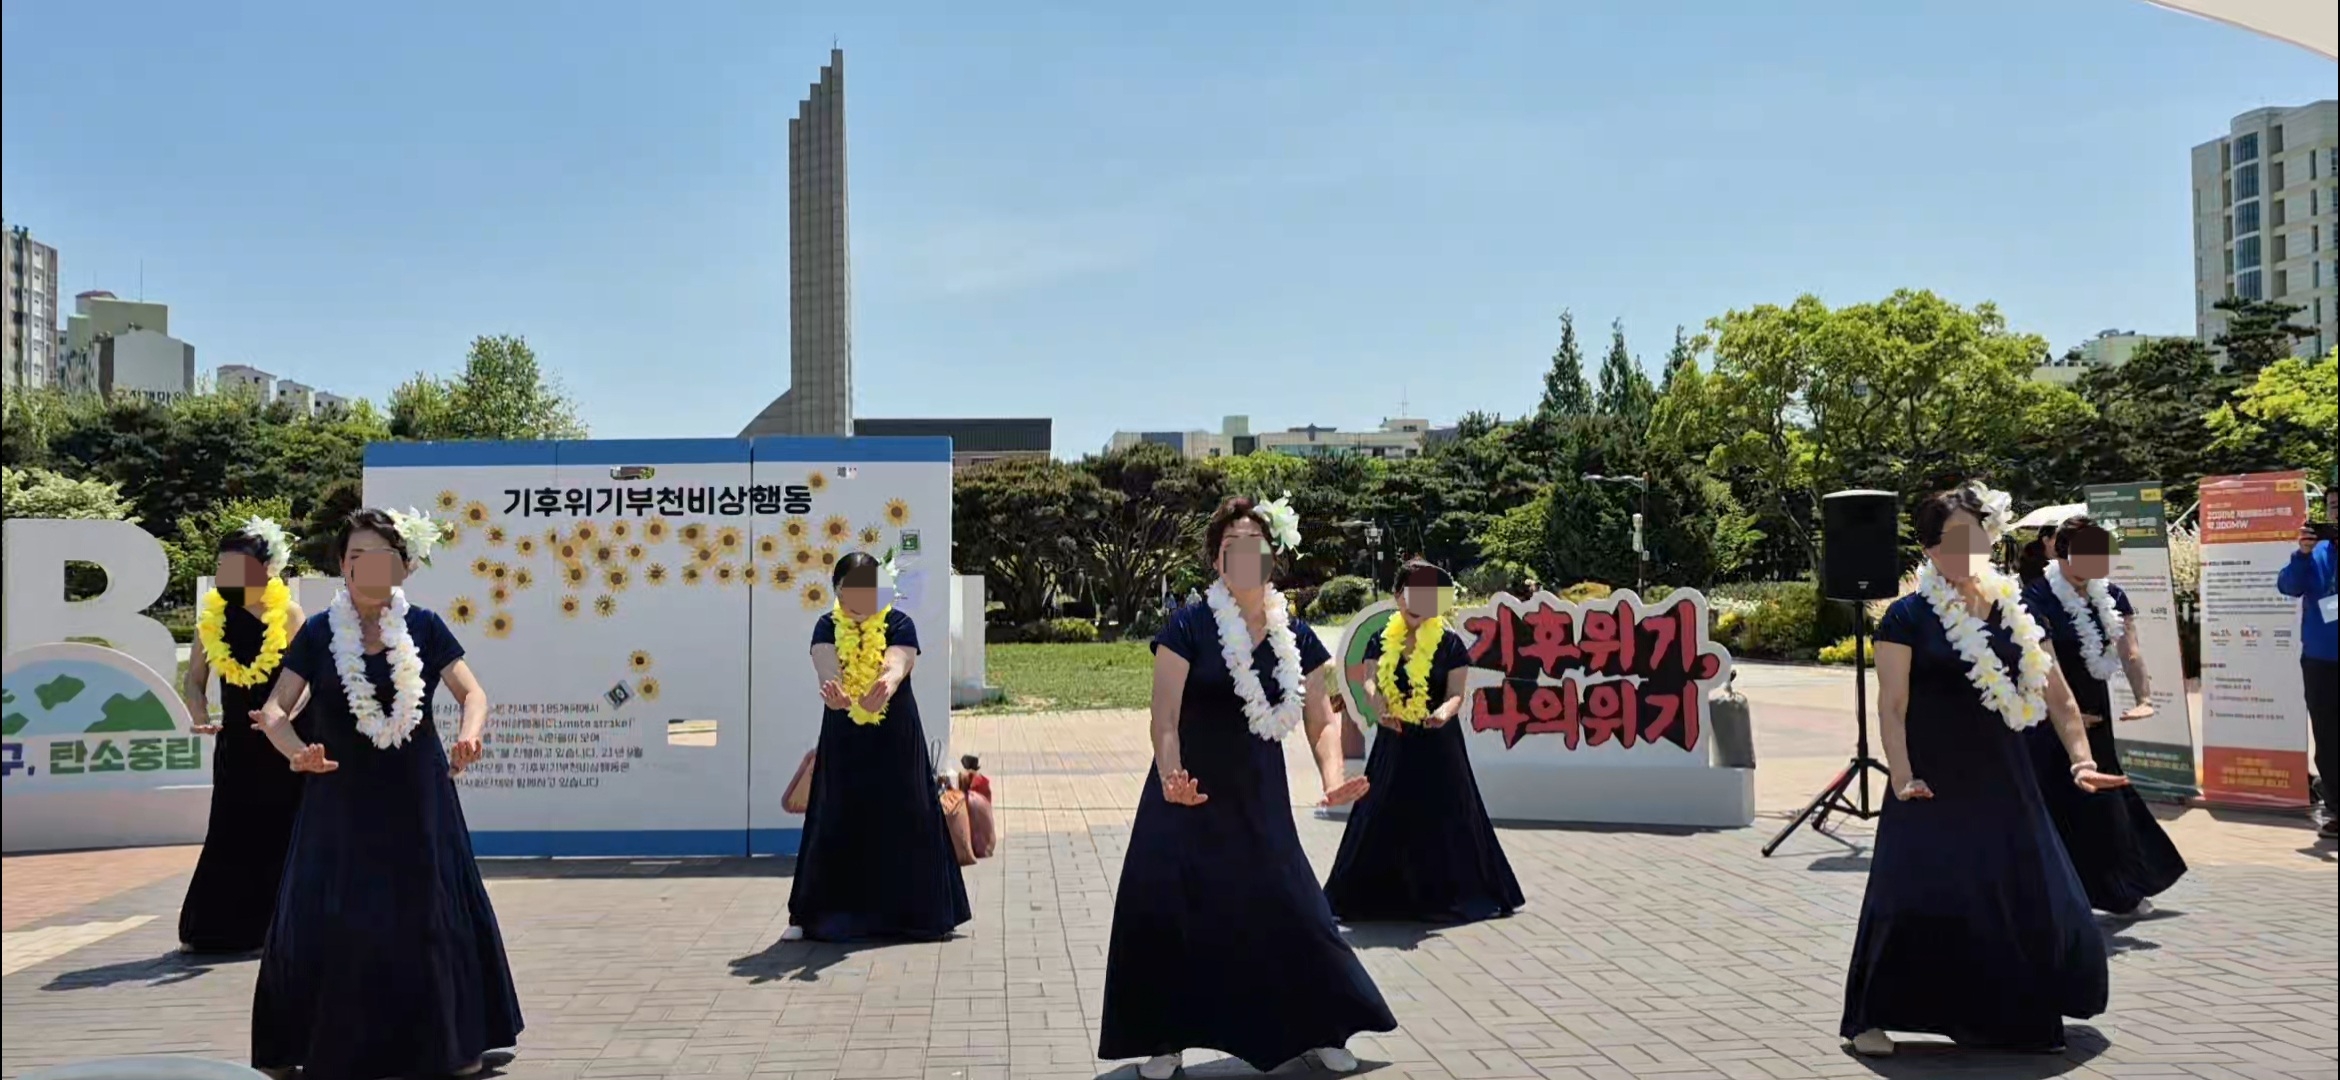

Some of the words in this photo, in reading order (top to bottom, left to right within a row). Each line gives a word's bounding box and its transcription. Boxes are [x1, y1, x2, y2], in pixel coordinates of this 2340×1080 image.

[504, 485, 812, 517] 기후위기부천비상행동
[1464, 599, 1720, 680] 기후위기,
[50, 737, 201, 774] 탄소중립
